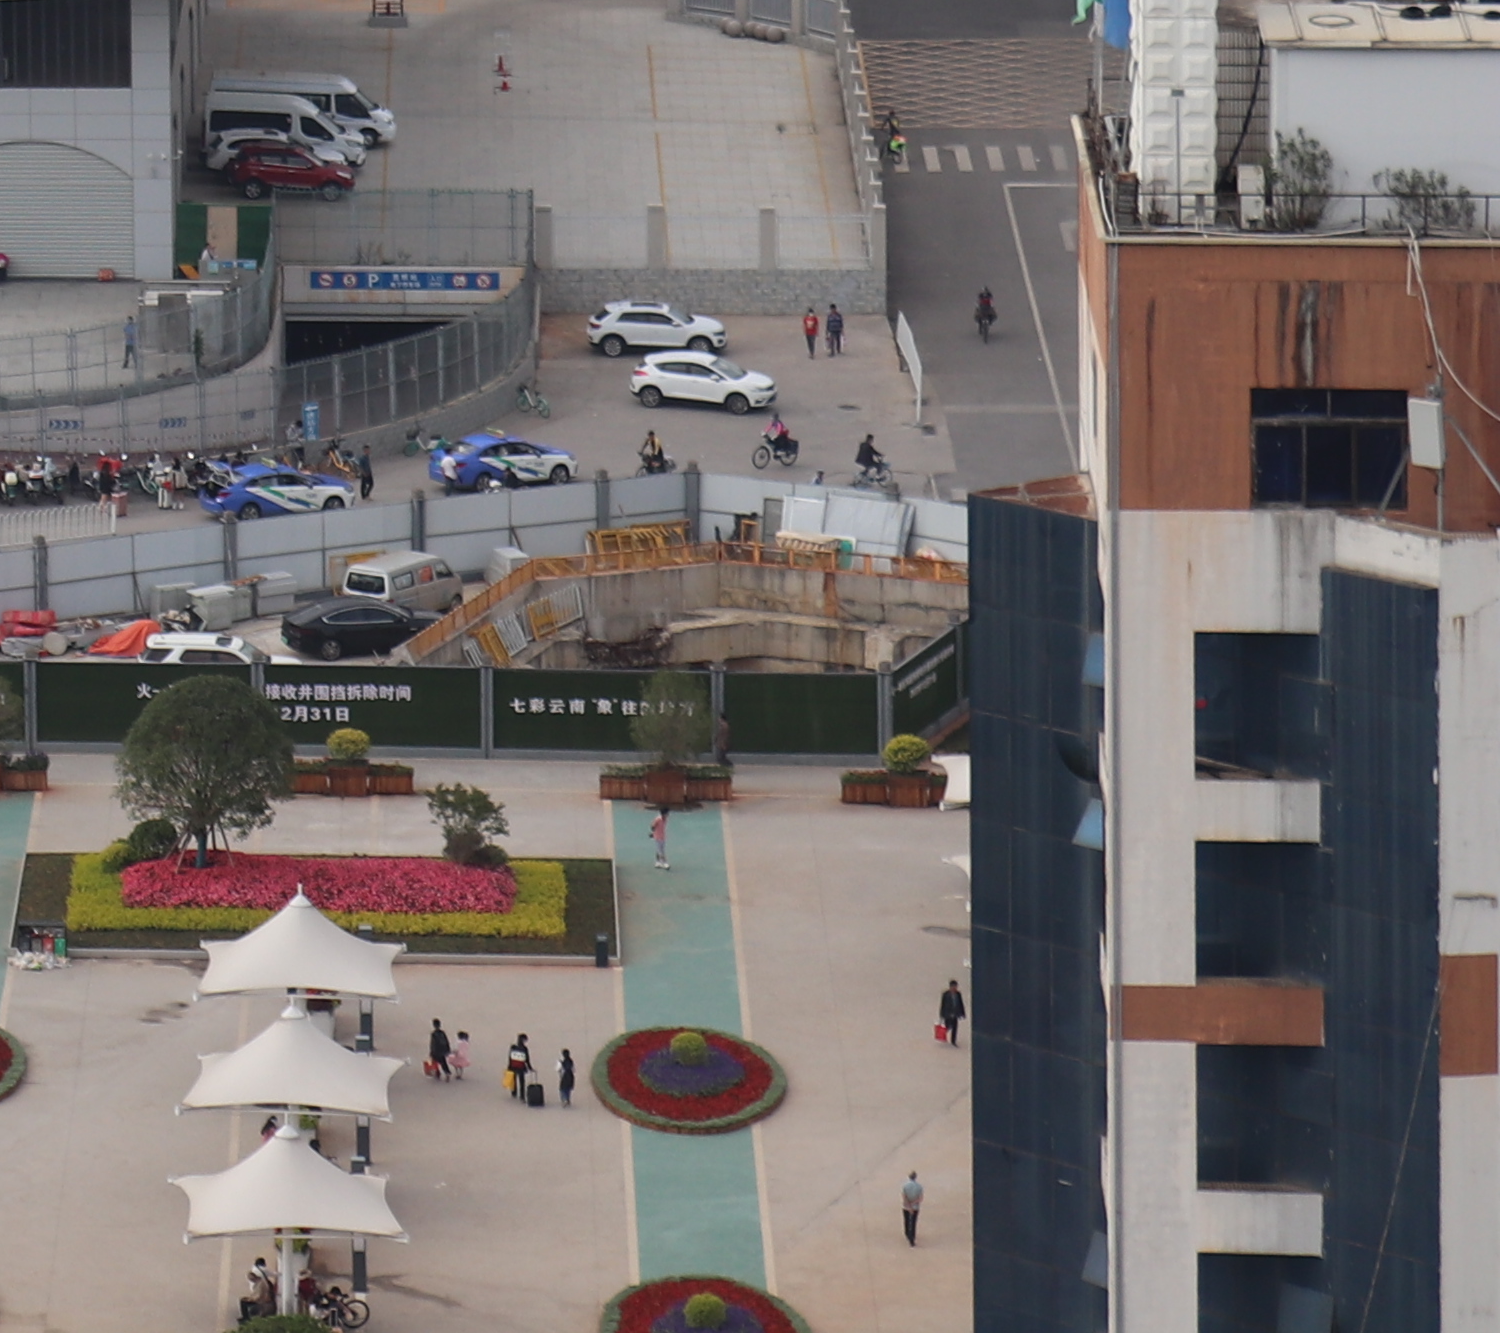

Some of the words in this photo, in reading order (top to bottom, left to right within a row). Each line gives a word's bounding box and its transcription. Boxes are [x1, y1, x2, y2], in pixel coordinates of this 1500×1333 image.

[368, 274, 380, 288] P
[265, 683, 412, 703] 接收井围挡拆除时间
